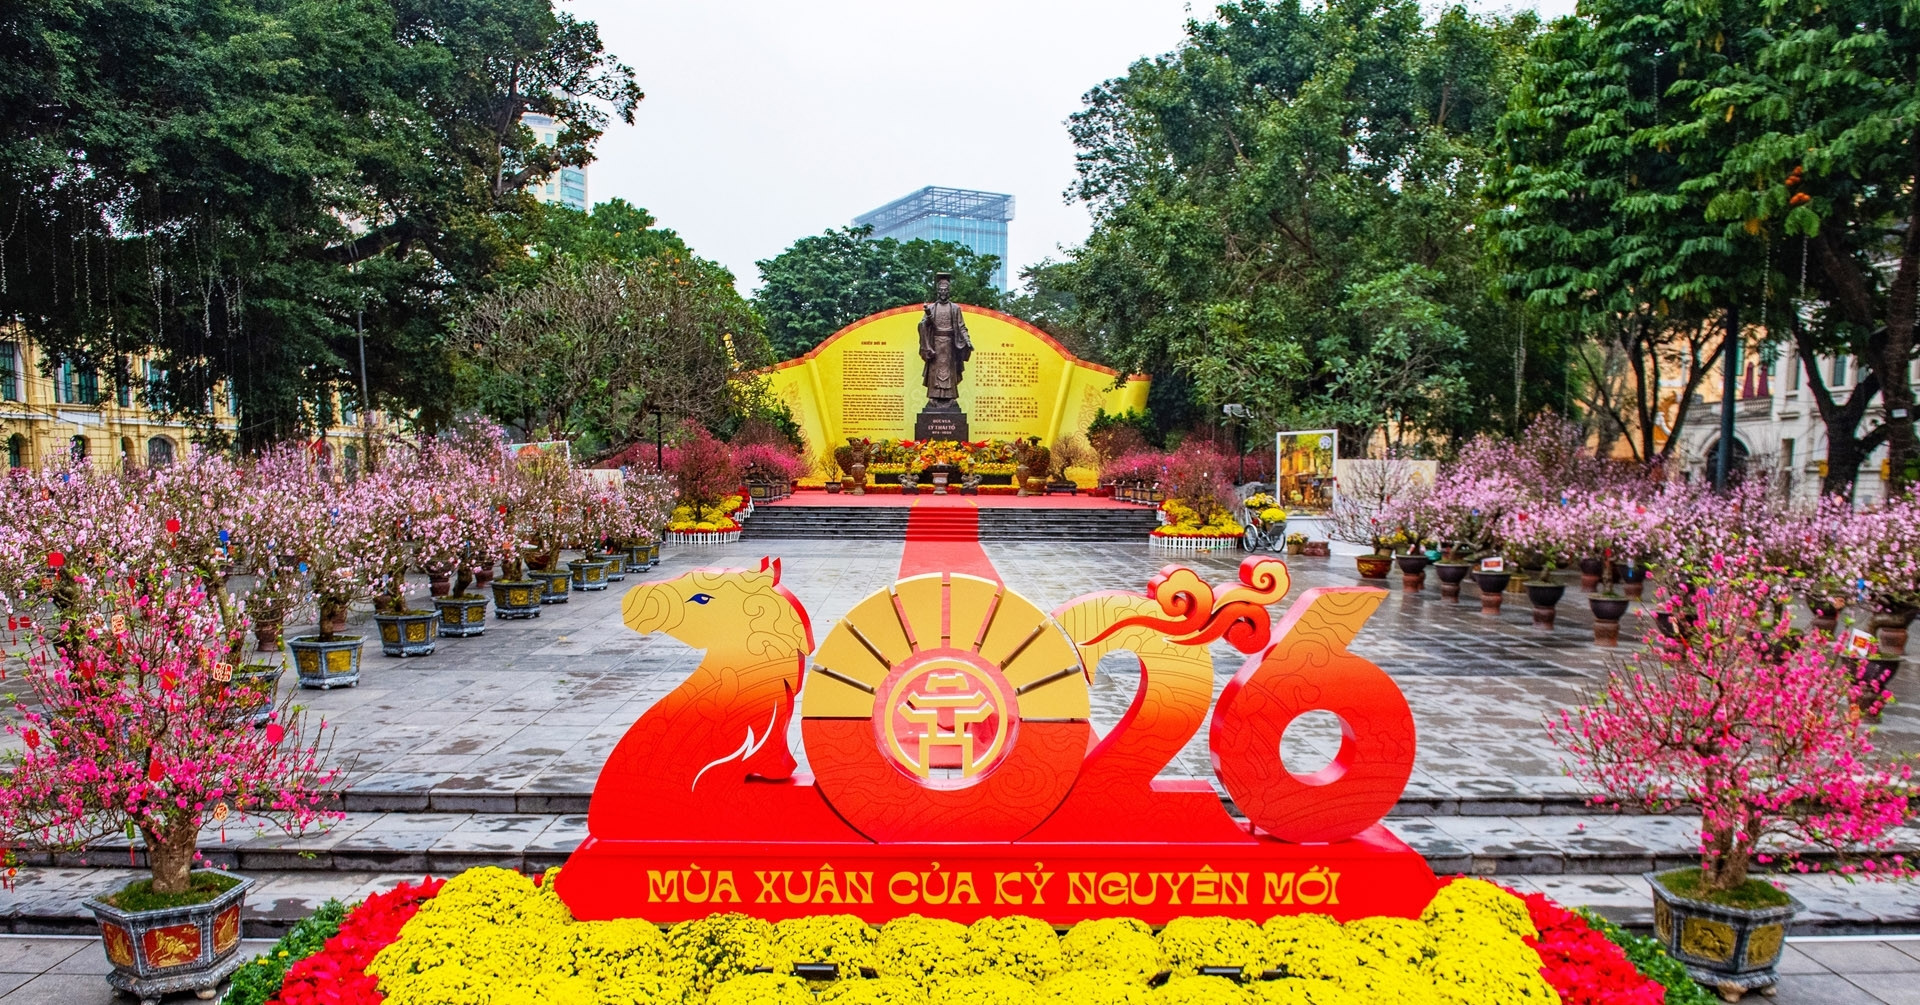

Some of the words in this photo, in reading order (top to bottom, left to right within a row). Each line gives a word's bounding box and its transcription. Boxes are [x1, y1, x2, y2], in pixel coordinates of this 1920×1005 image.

[647, 863, 745, 905] MÙA
[755, 863, 873, 905] XUÂN
[888, 862, 980, 905] CỦA
[995, 862, 1053, 905] KỶ
[1067, 864, 1248, 905] NGUYÊN
[1264, 865, 1340, 905] MỚI
